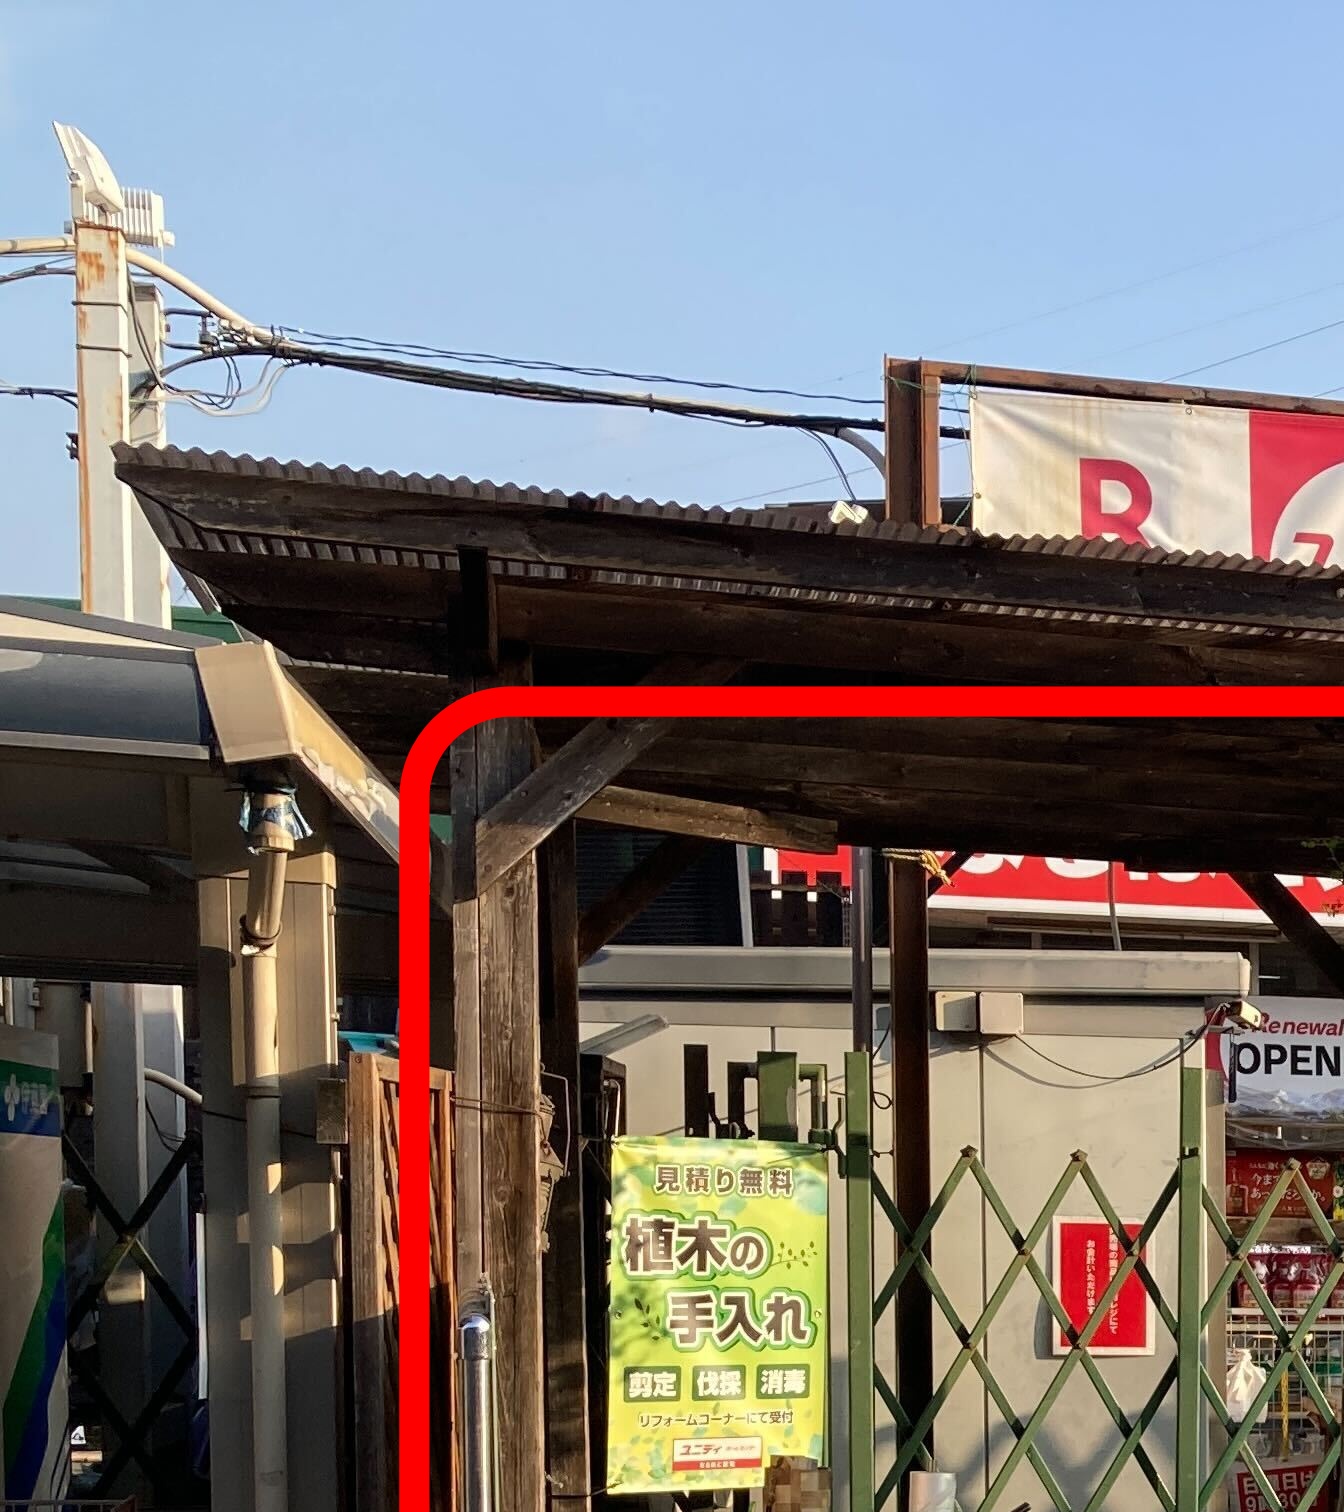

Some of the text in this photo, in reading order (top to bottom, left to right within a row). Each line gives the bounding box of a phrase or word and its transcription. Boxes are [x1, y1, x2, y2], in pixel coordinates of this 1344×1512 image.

[655, 1165, 793, 1196] 見積り無料
[625, 1216, 765, 1274] 植木の
[669, 1295, 808, 1345] 手入れ
[628, 1369, 806, 1399] 剪定 伐採 消毒
[640, 1410, 794, 1428] リフォームコーナーにて受付
